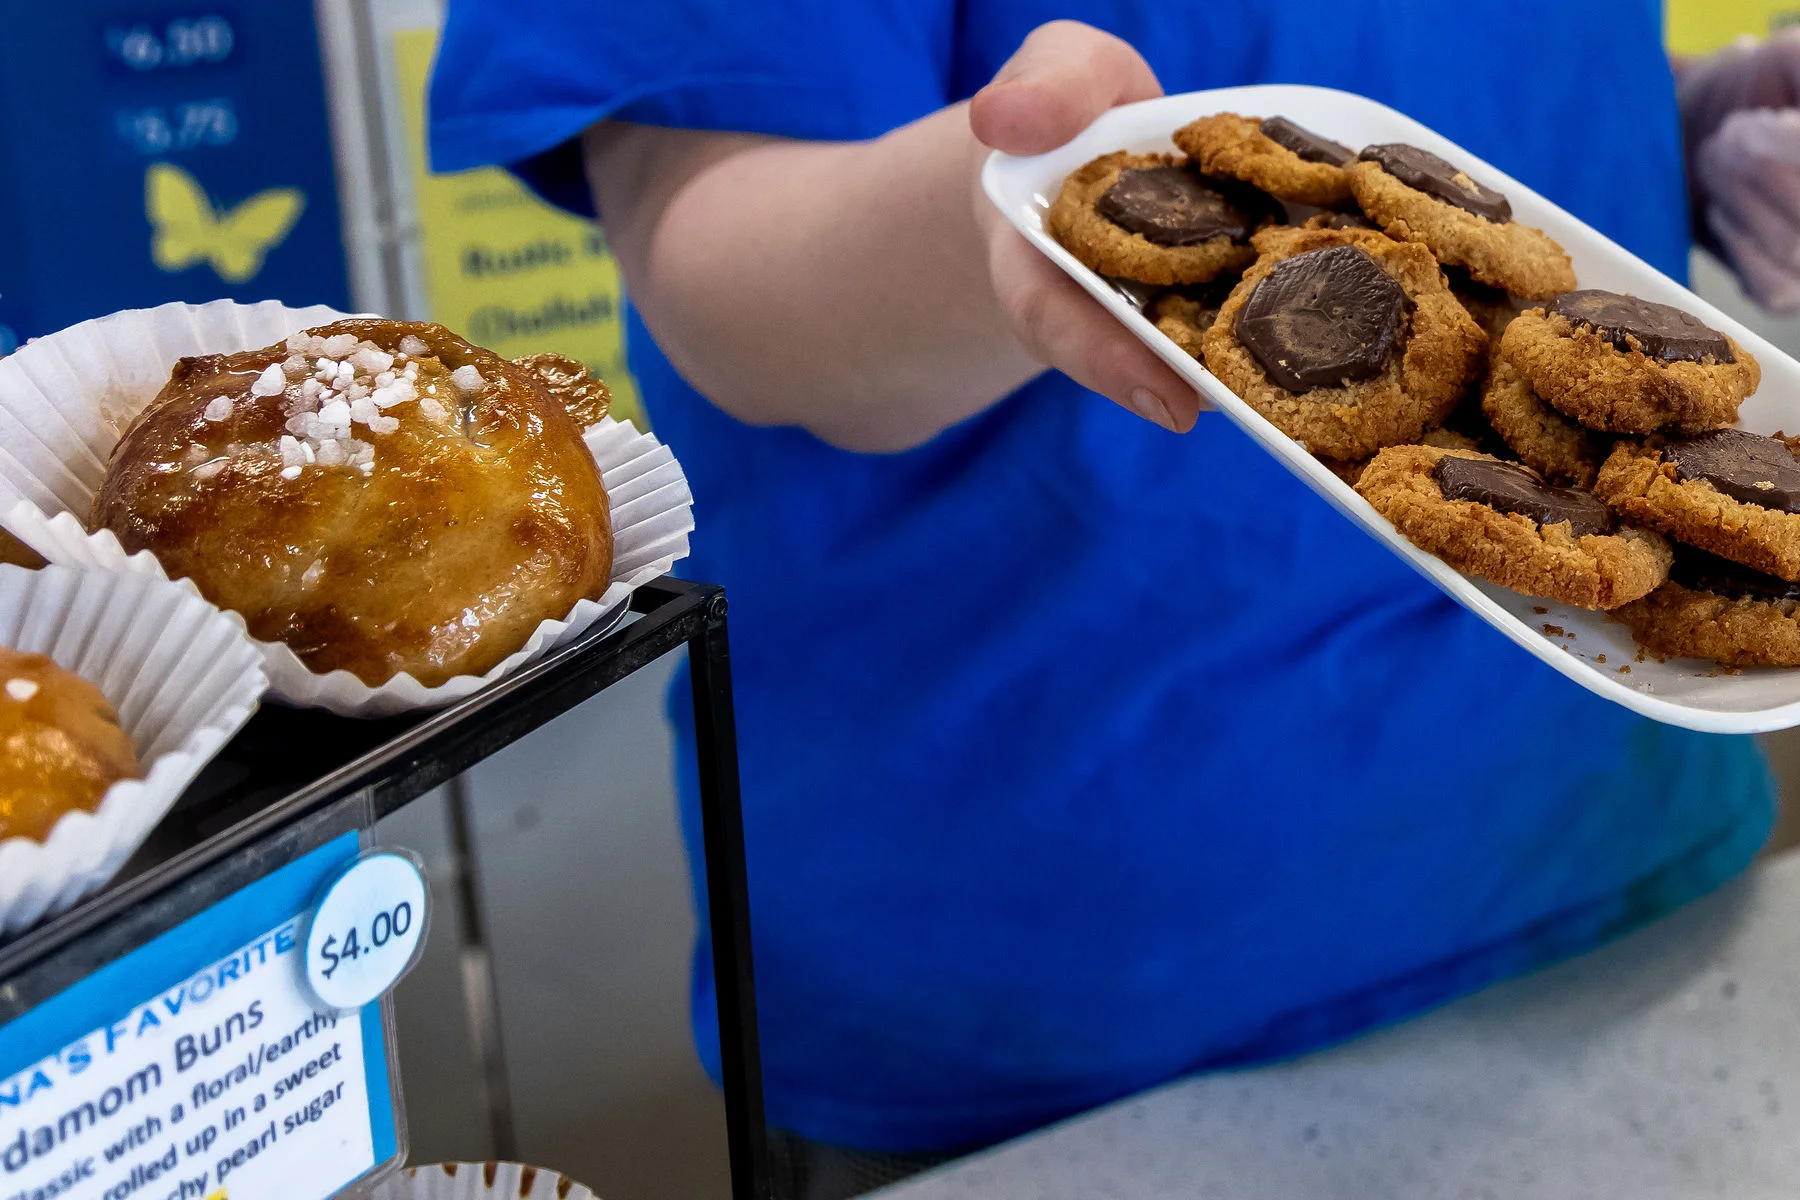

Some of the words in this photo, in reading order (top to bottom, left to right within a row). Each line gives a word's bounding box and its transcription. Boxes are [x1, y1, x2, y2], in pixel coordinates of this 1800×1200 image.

[319, 902, 412, 979] $4.00
[103, 1116, 162, 1164] with
[169, 1102, 185, 1125] a
[190, 1008, 340, 1110] floral/earthy
[173, 999, 265, 1074] Buns
[102, 1142, 178, 1200] rolled
[184, 1124, 218, 1157] up
[223, 1106, 246, 1132] in
[252, 1092, 267, 1113] a
[272, 1042, 343, 1101] sweet
[215, 1119, 278, 1185] pearl
[282, 1080, 345, 1136] sugar
